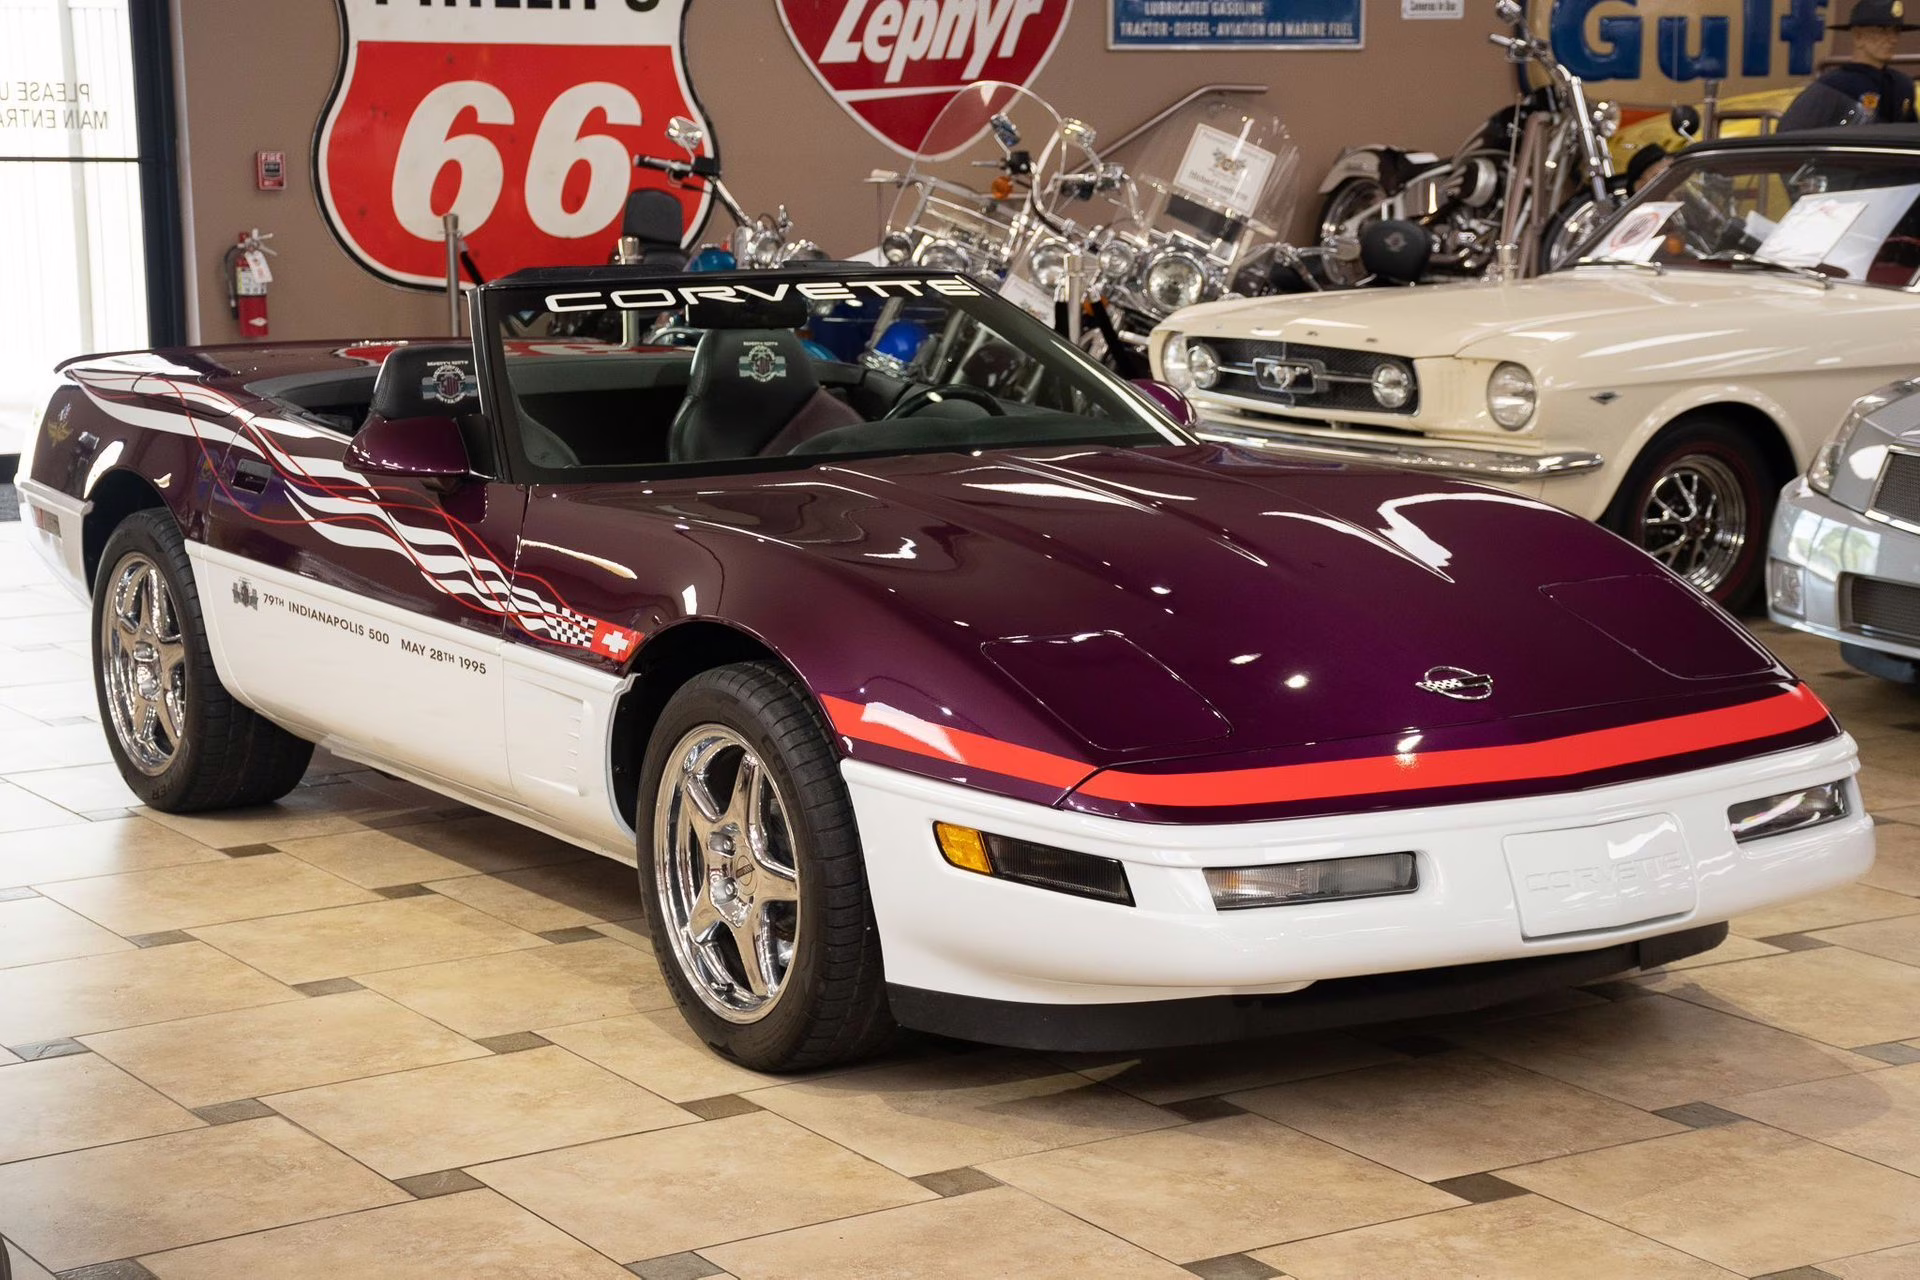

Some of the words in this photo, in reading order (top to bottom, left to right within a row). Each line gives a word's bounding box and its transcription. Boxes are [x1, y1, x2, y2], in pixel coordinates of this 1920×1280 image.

[818, 0, 1046, 83] Zephyr
[1267, 22, 1283, 36] OR
[1327, 22, 1353, 36] FUEL
[1551, 0, 1829, 81] Gulf
[391, 80, 642, 242] 66
[545, 279, 981, 313] CORVETTE
[263, 592, 285, 608] 79TH
[288, 601, 364, 636] INDIANAPOLIS
[368, 628, 390, 645] 500
[401, 638, 426, 656] MAY
[429, 648, 455, 664] 28TH
[458, 656, 487, 675] 1995
[1525, 851, 1683, 892] CORVETTE
